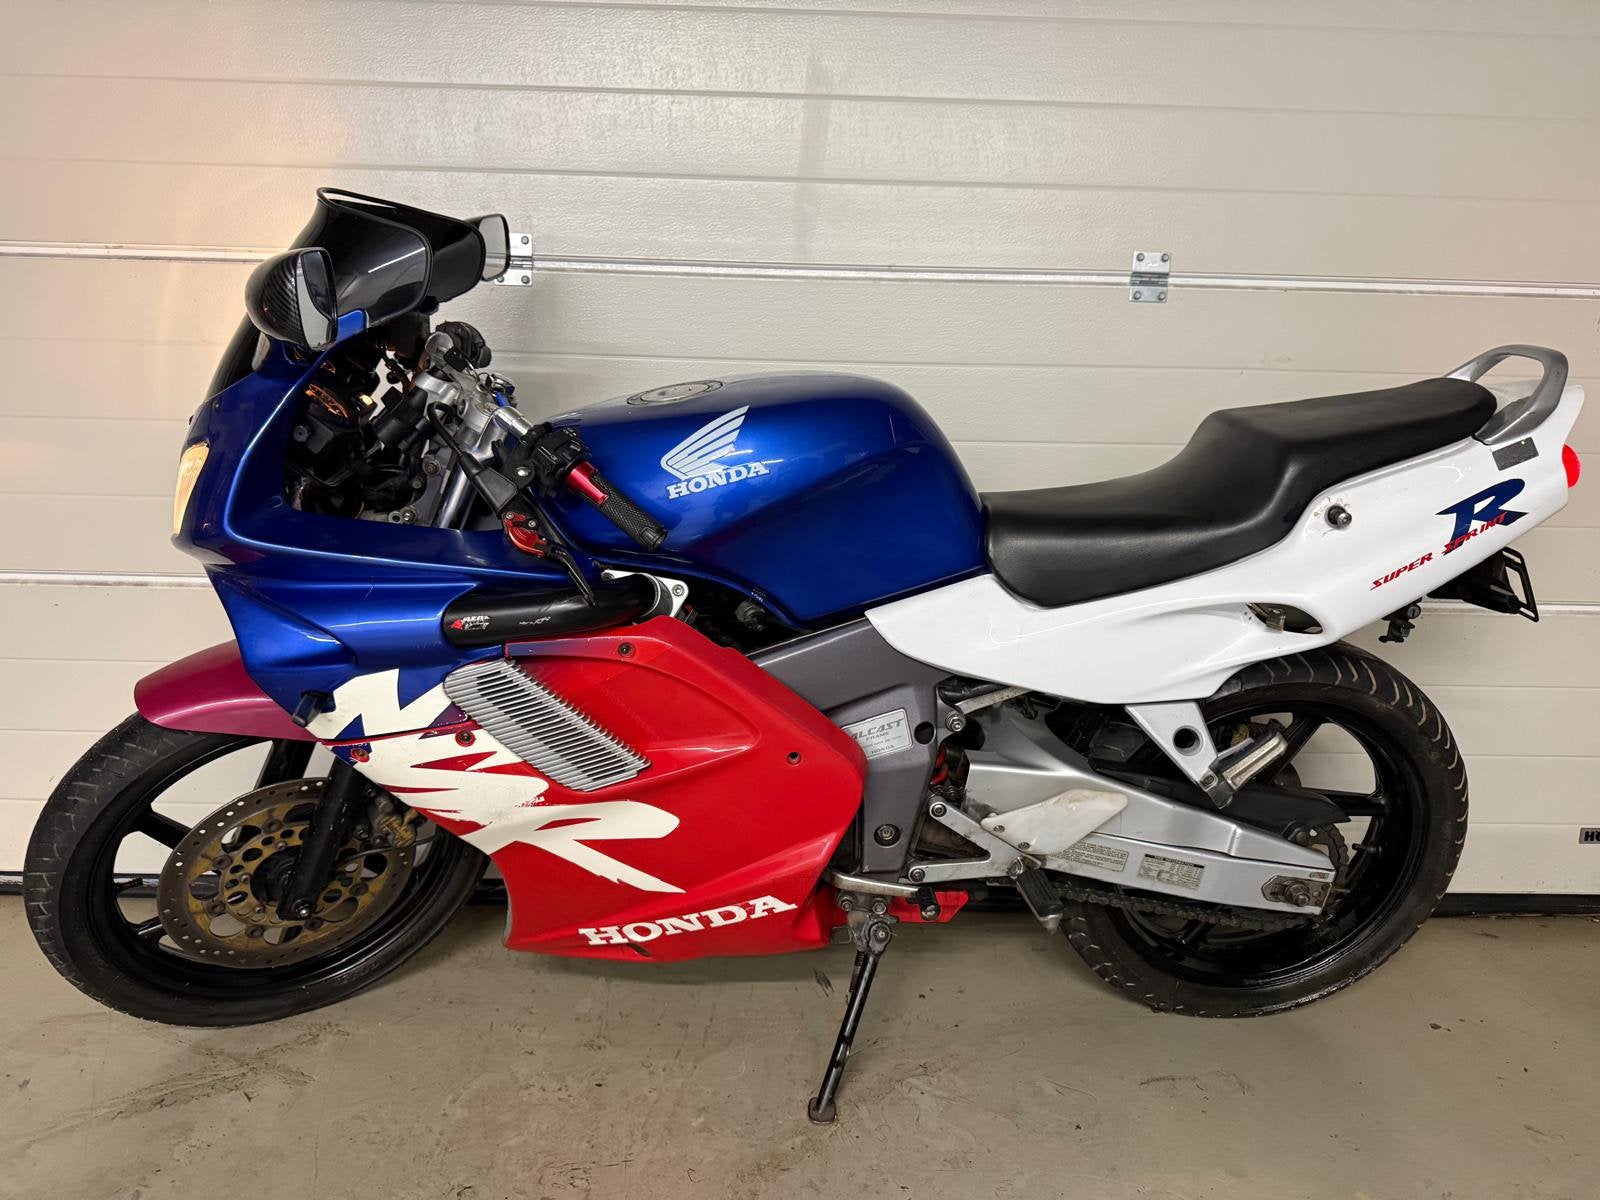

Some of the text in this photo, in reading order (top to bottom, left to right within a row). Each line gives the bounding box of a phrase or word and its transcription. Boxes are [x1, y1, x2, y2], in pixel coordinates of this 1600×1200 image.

[666, 461, 769, 499] HONDA
[1435, 478, 1529, 556] R
[1370, 552, 1433, 590] SUPER
[578, 895, 798, 945] HONDA
